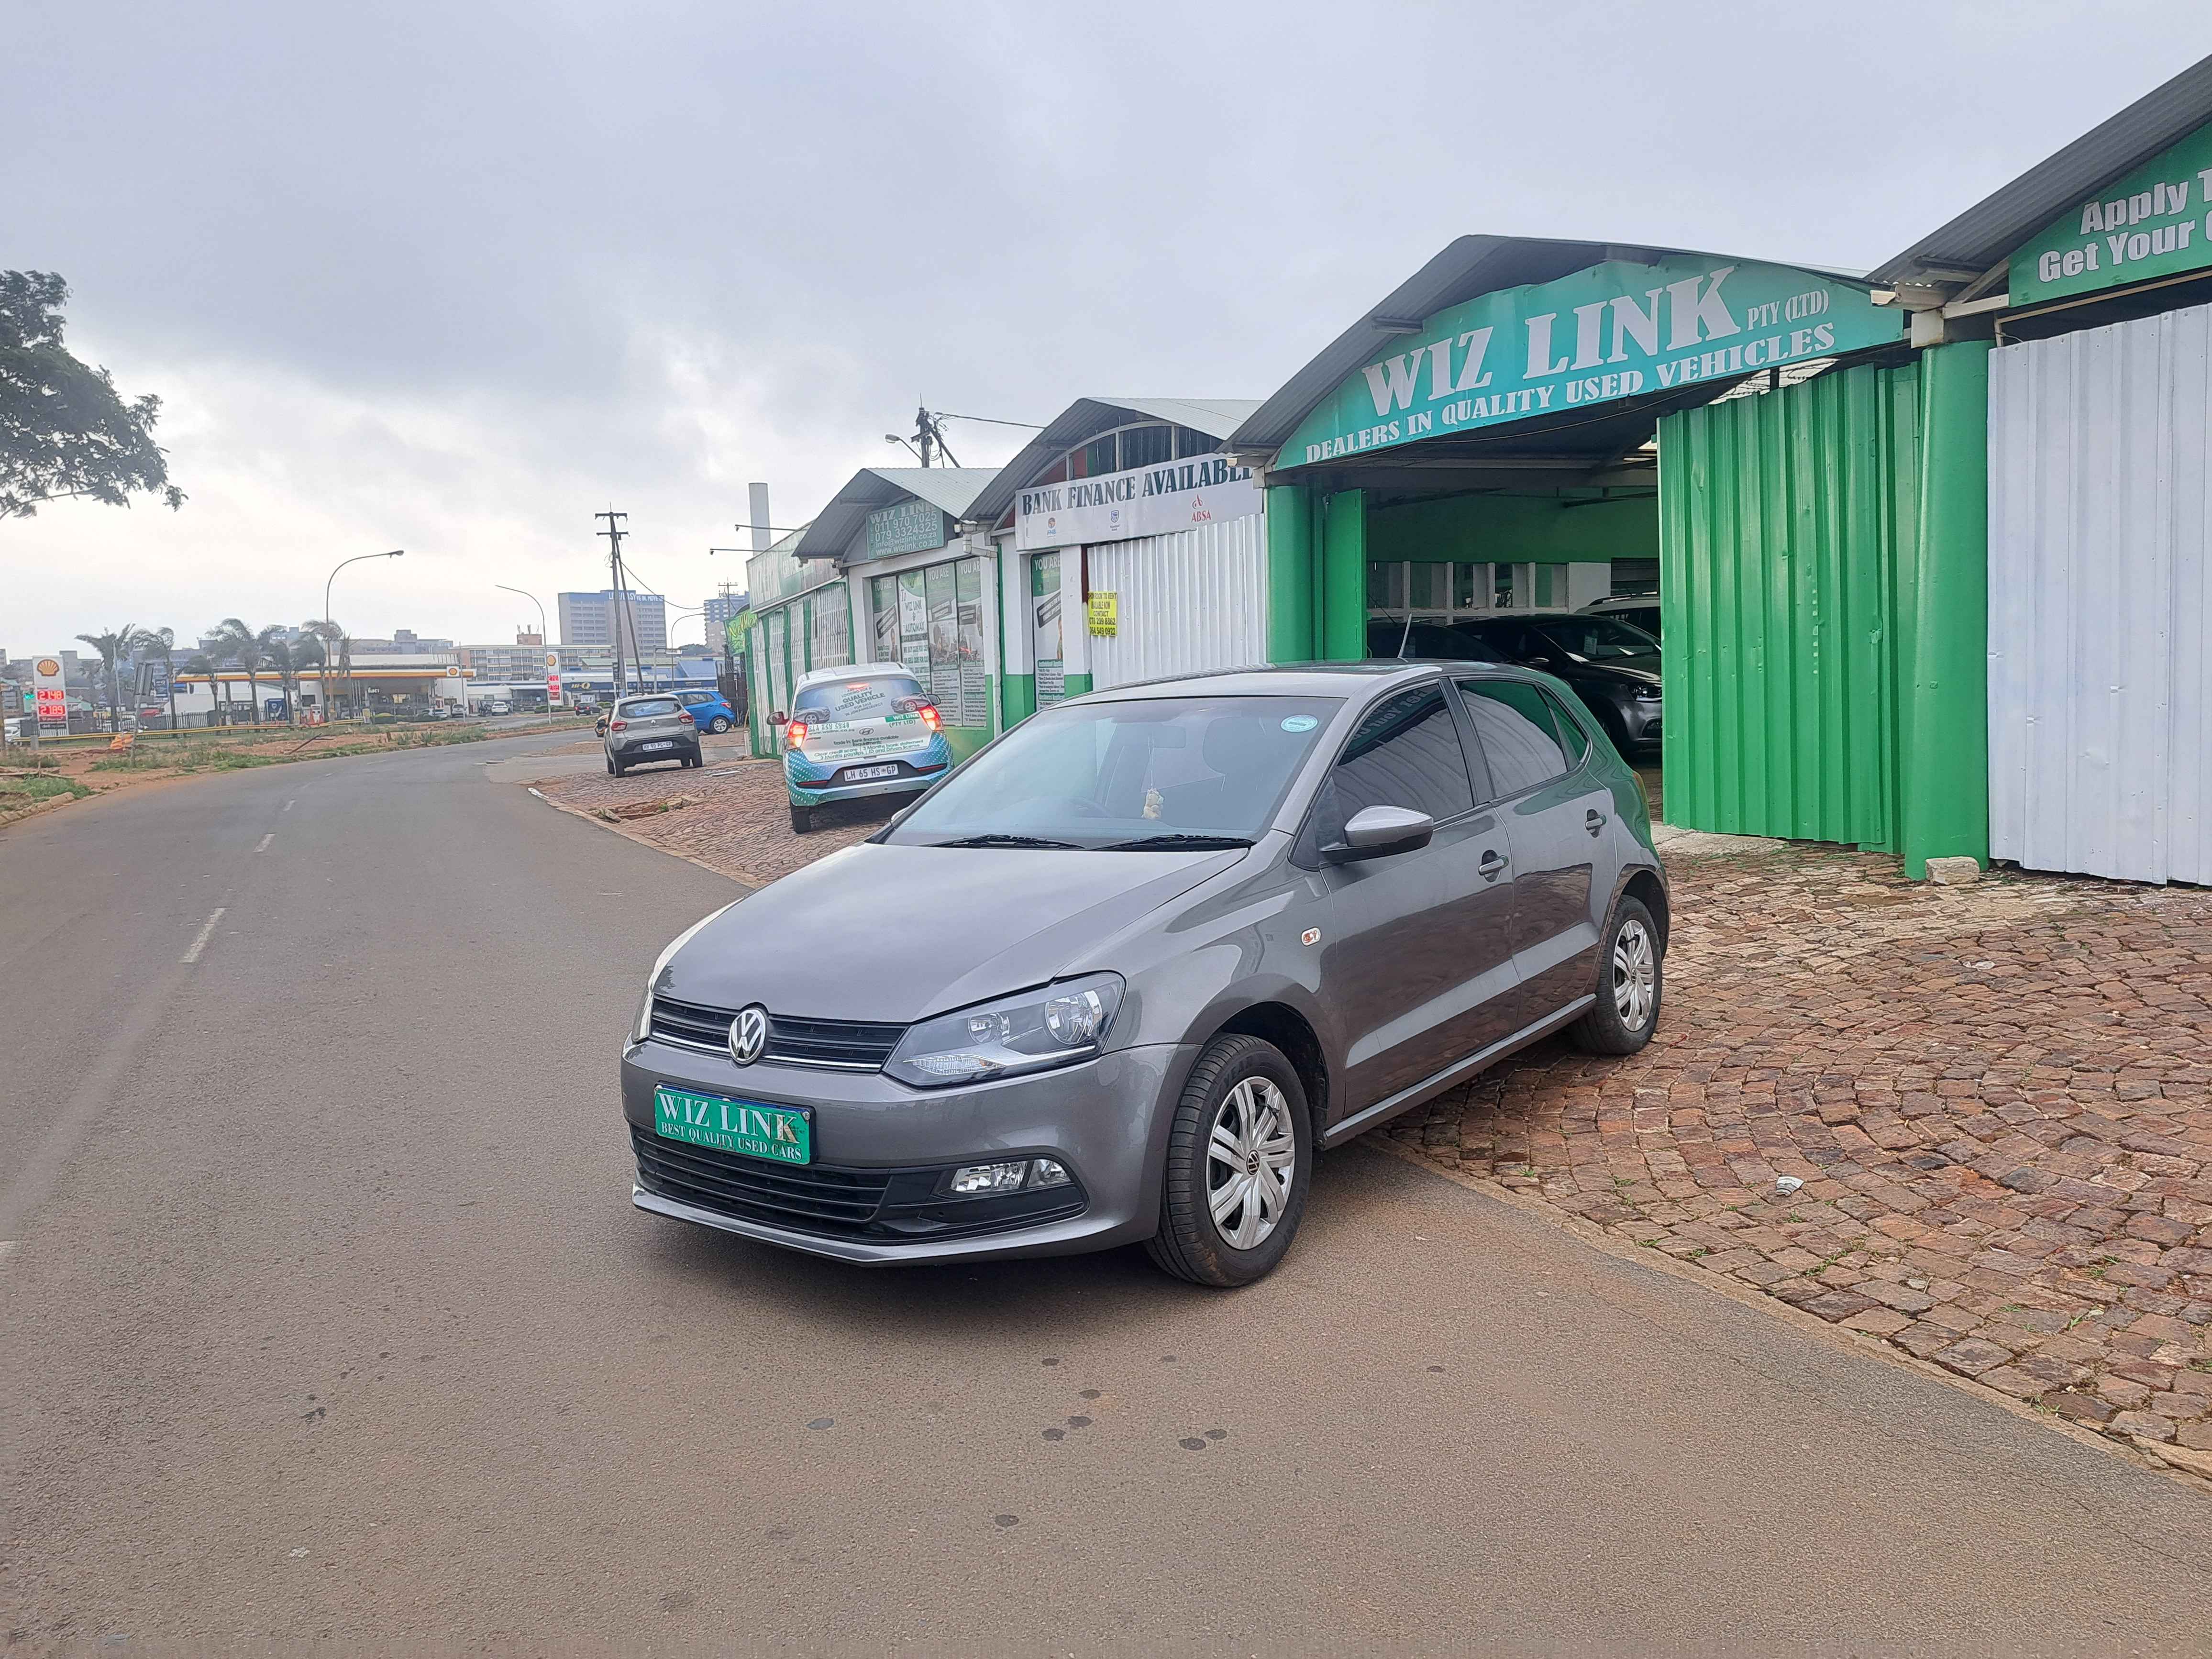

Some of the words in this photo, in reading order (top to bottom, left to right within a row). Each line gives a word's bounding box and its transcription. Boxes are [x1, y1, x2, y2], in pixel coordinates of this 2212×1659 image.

[2079, 180, 2189, 235] Apply
[2039, 242, 2099, 283] Get
[2106, 220, 2195, 265] Your
[1362, 326, 1493, 416] WIZ
[1523, 266, 1741, 380] LINK
[1747, 300, 1780, 331] PTY
[1784, 289, 1829, 323] (LTD)
[1305, 420, 1399, 463] DEALERS
[1407, 410, 1432, 435] IN
[1441, 385, 1555, 425] QUALITY
[1566, 370, 1643, 404] USED
[1656, 322, 1835, 387] VEHICLES
[1022, 489, 1062, 516] BANK
[1067, 476, 1136, 509] FINANCE
[869, 509, 896, 524] WIZ
[875, 520, 889, 532] 011
[893, 517, 909, 529] 970
[912, 510, 937, 525] 7025
[1191, 510, 1211, 522] ABSA
[875, 530, 892, 542] 079
[895, 520, 938, 538] 3324325
[876, 539, 938, 555] www.wizlink.co.za
[929, 569, 939, 580] YOU
[940, 567, 949, 578] ARE
[961, 563, 972, 574] YOU
[1034, 559, 1048, 571] YOU
[874, 580, 884, 591] YOU
[835, 702, 854, 711] USED
[855, 693, 885, 704] VEHICLE
[842, 690, 872, 703] QUALITY
[846, 771, 855, 779] LH
[859, 770, 868, 778] 65
[872, 767, 880, 776] HS
[887, 765, 896, 774] GP
[657, 1093, 710, 1128] WIZ
[719, 1104, 800, 1144] LINK
[662, 1122, 686, 1137] BEST
[689, 1127, 735, 1148] QUALITY
[738, 1138, 768, 1153] USED
[772, 1144, 802, 1160] CARS
